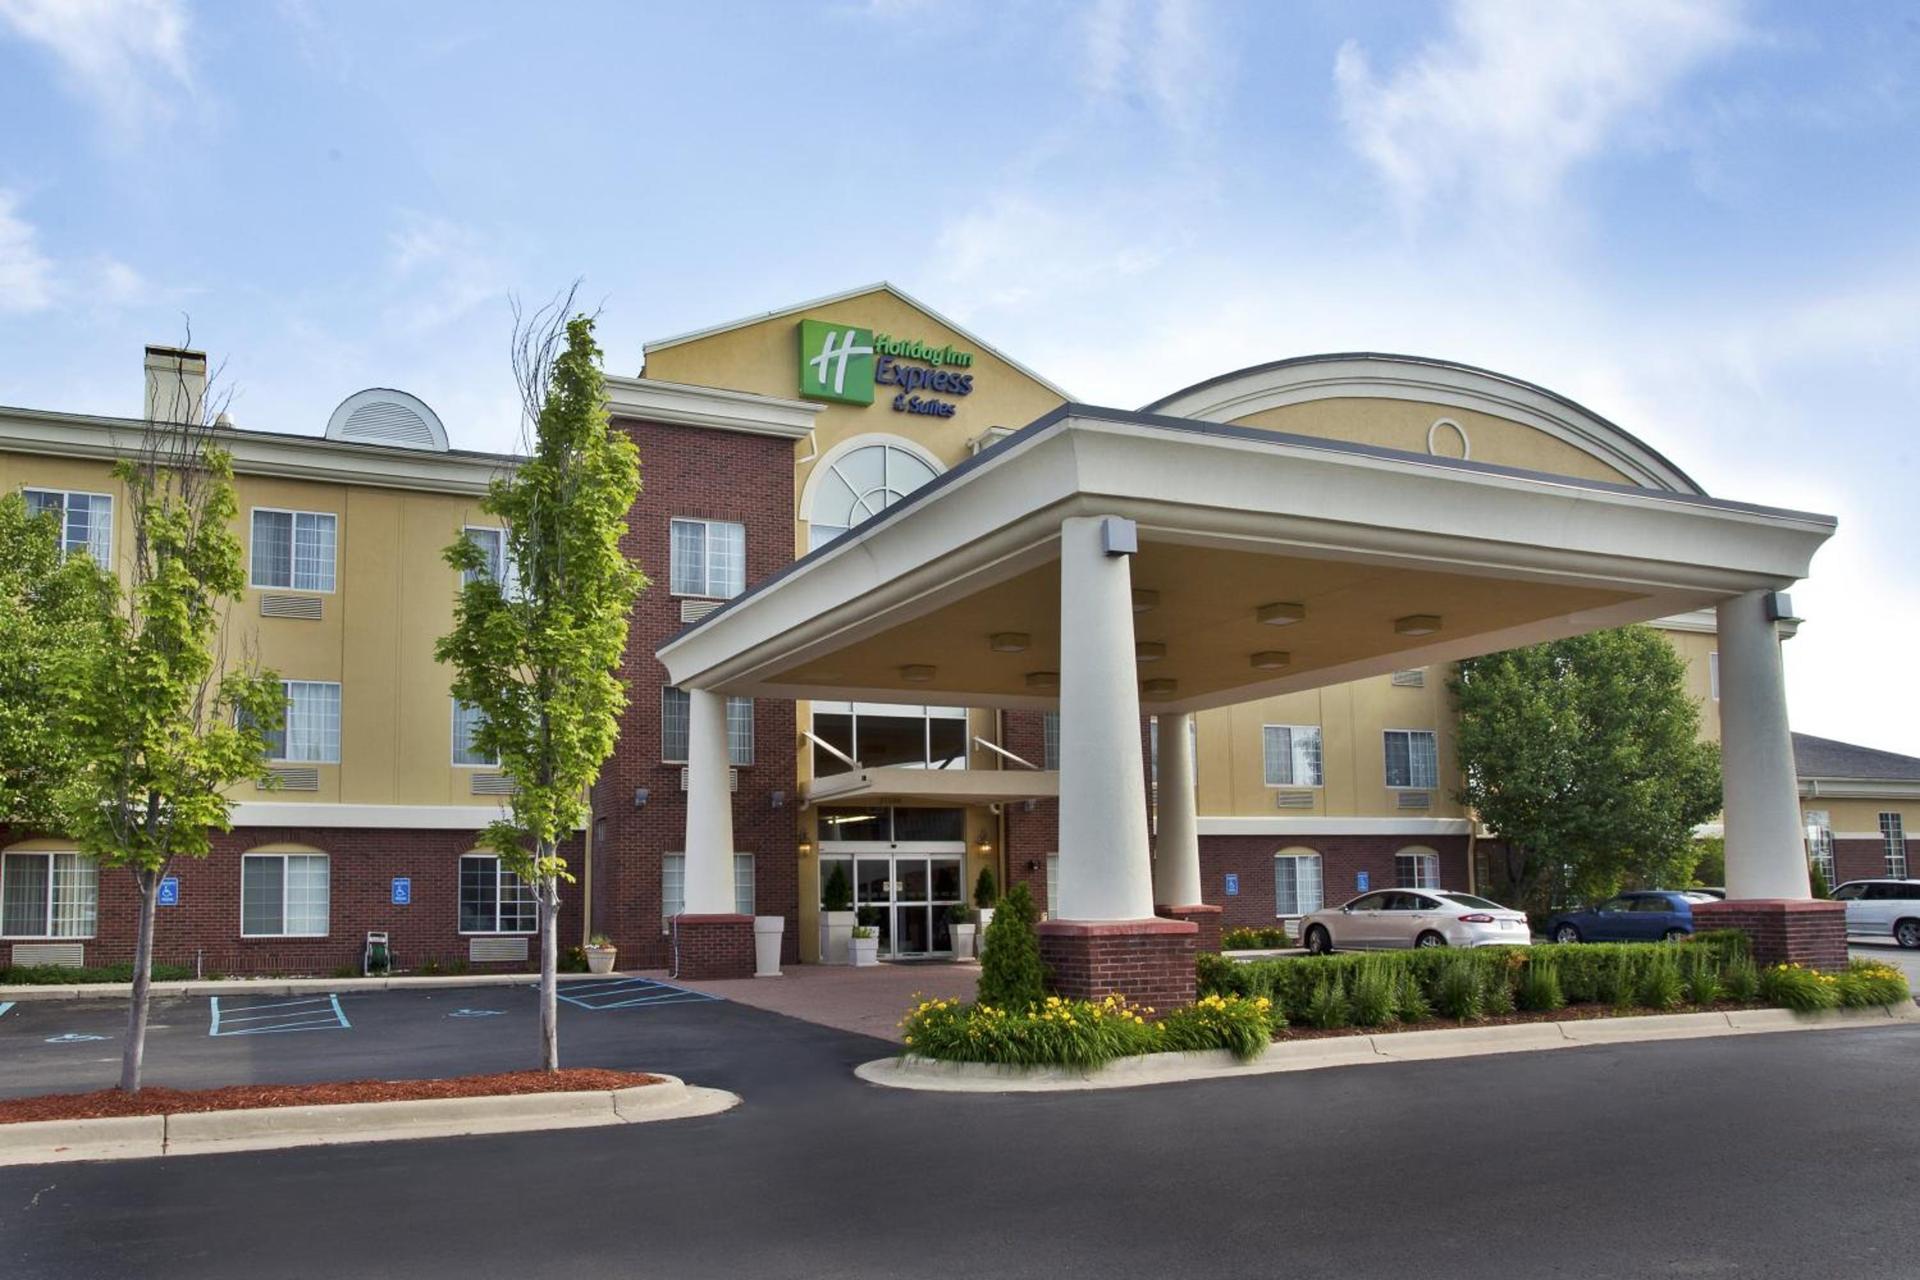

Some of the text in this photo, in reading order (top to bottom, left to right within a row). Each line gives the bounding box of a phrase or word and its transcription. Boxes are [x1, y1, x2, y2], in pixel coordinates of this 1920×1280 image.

[874, 334, 973, 367] Holiday Inn
[875, 355, 973, 395] Express
[892, 393, 956, 417] & Suites
